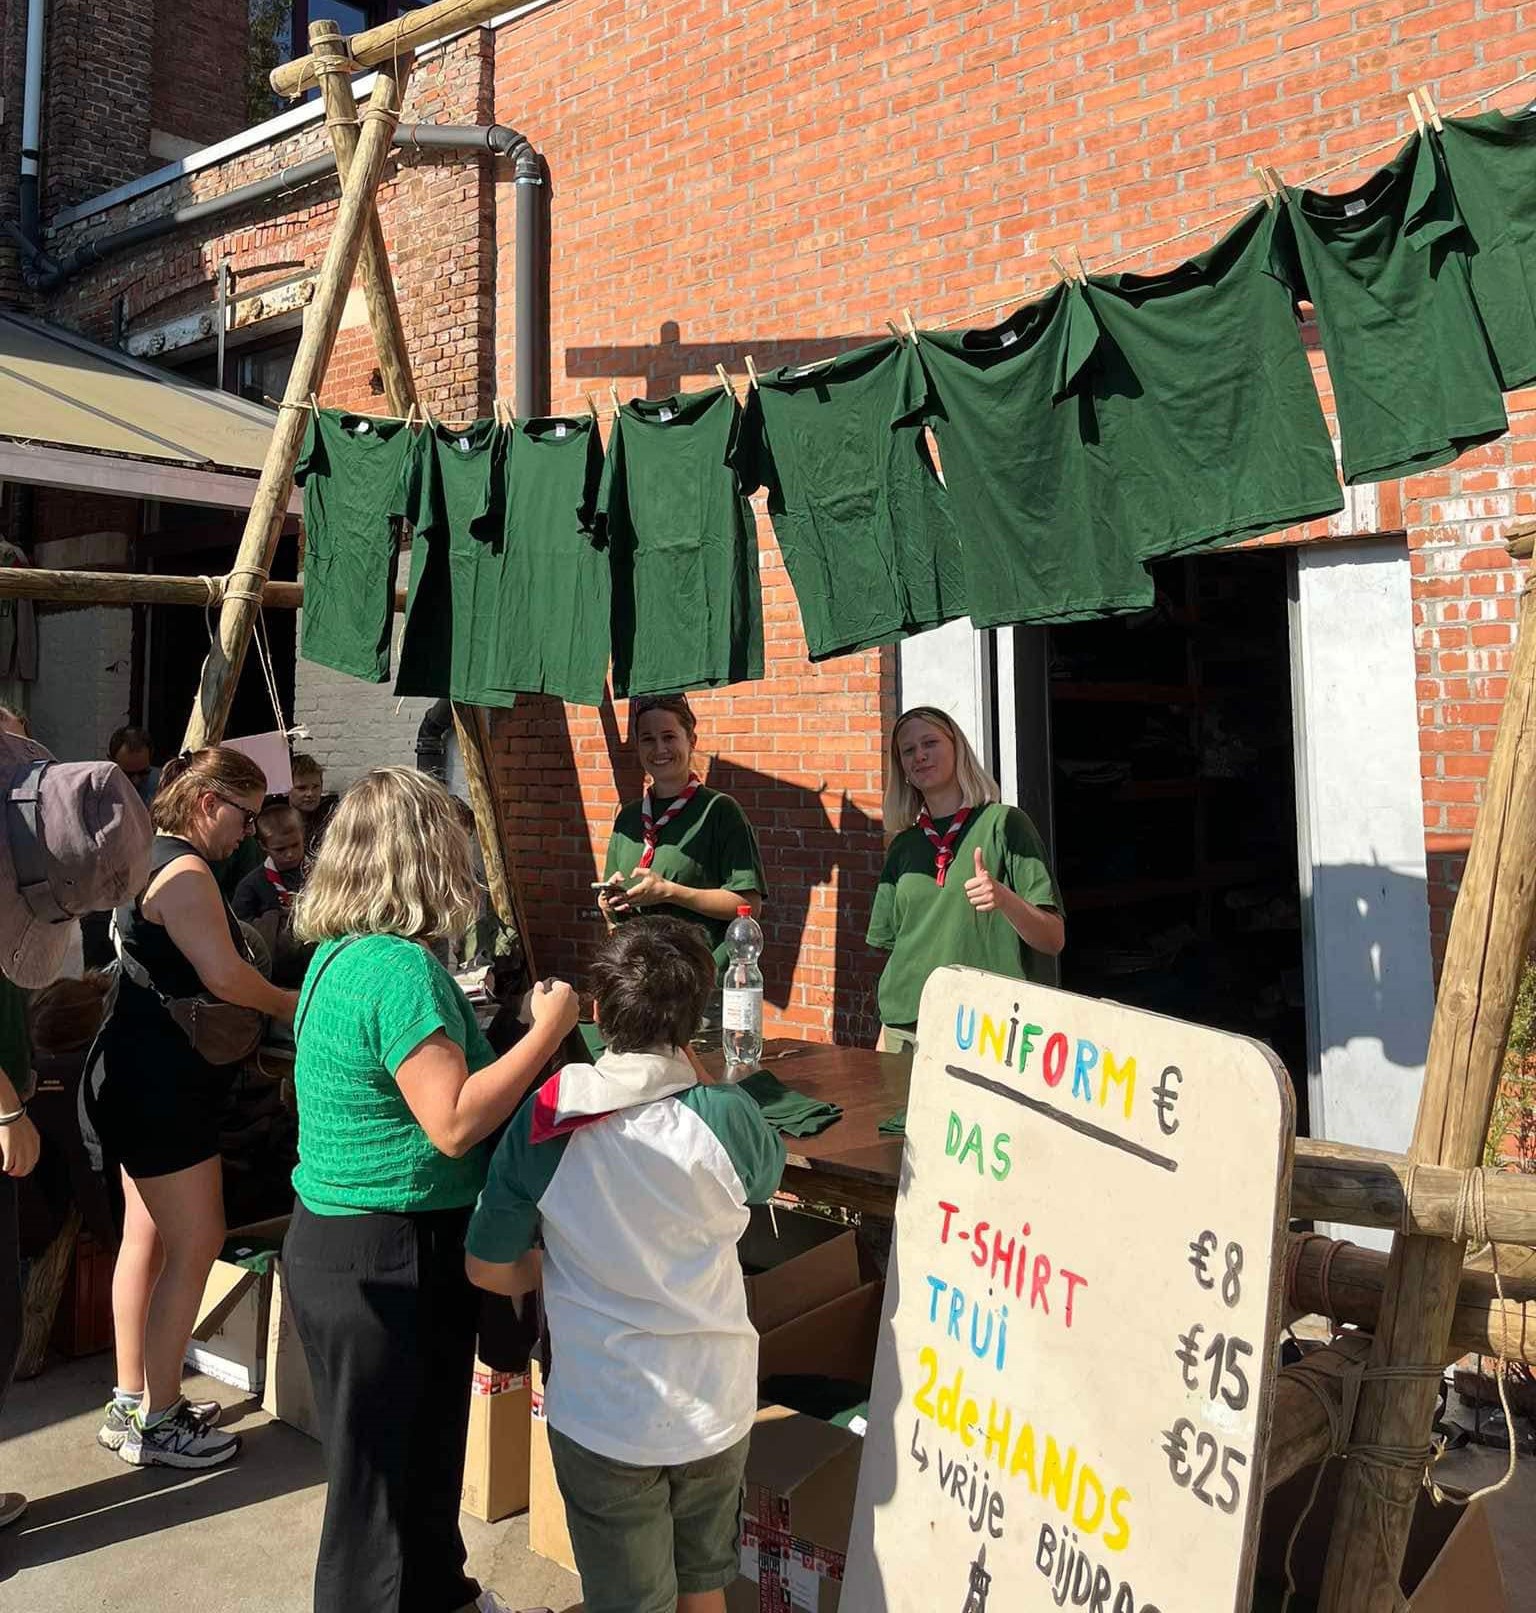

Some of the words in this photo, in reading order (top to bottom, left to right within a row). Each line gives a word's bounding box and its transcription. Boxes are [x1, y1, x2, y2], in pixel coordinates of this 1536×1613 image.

[1152, 1065, 1184, 1136] €
[945, 1110, 1012, 1182] DAS
[1188, 1229, 1244, 1308] €8
[1175, 1323, 1254, 1411] €15
[1161, 1416, 1247, 1515] €25
